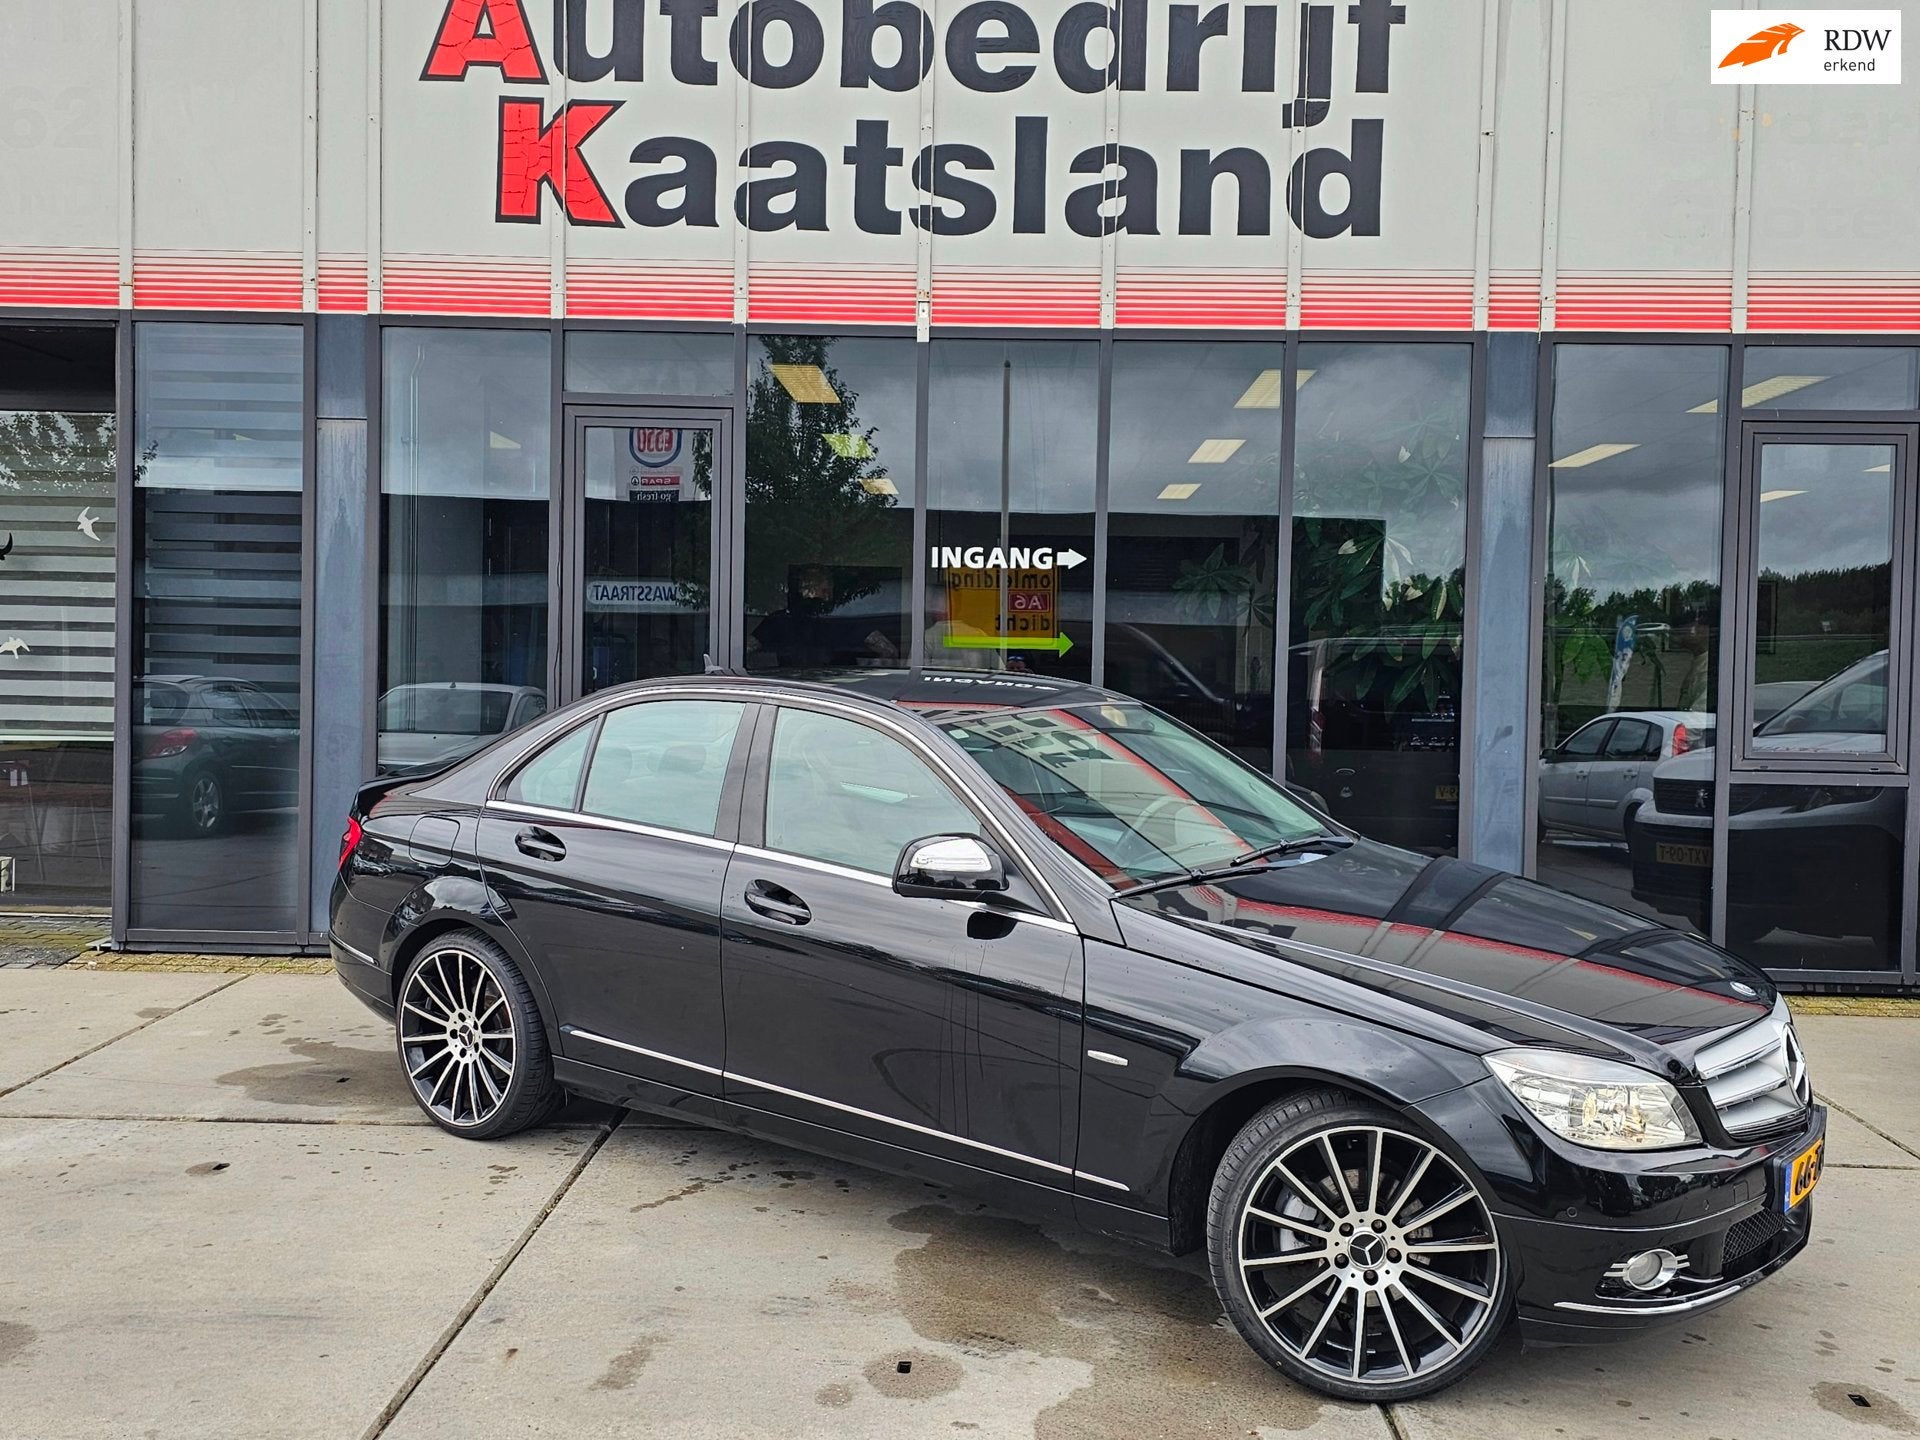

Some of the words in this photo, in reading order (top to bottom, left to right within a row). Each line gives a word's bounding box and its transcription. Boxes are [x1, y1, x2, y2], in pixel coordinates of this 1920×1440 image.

[419, 0, 1406, 128] Autobedrijf
[495, 96, 1385, 238] Kaatsland
[931, 546, 1054, 570] INGANG
